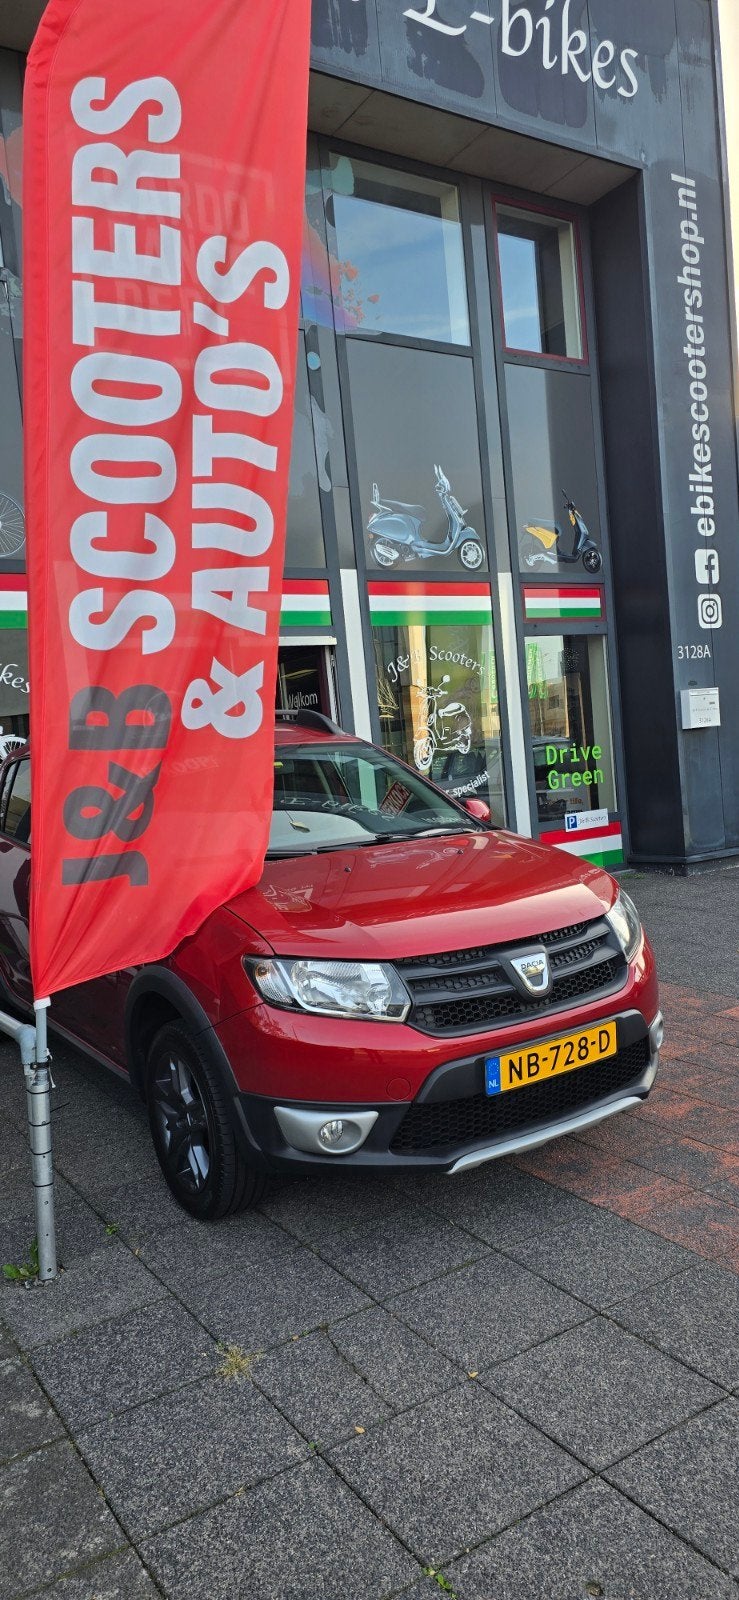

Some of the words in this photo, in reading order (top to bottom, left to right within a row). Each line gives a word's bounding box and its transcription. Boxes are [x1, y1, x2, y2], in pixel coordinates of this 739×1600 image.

[69, 76, 183, 654] SCOOTERS
[670, 173, 716, 537] ebikescootershop.nl
[192, 235, 290, 636] AUTO'S
[429, 645, 486, 676] Scooters
[677, 645, 711, 660] 3128A
[0, 664, 30, 694] kes
[181, 657, 264, 739] &
[546, 743, 603, 765] Drive
[62, 685, 172, 886] J&B
[453, 770, 490, 797] specialist
[548, 769, 605, 789] Green
[520, 958, 544, 970] DACIA
[509, 1029, 611, 1083] NB-728-D
[488, 1078, 499, 1088] NL
